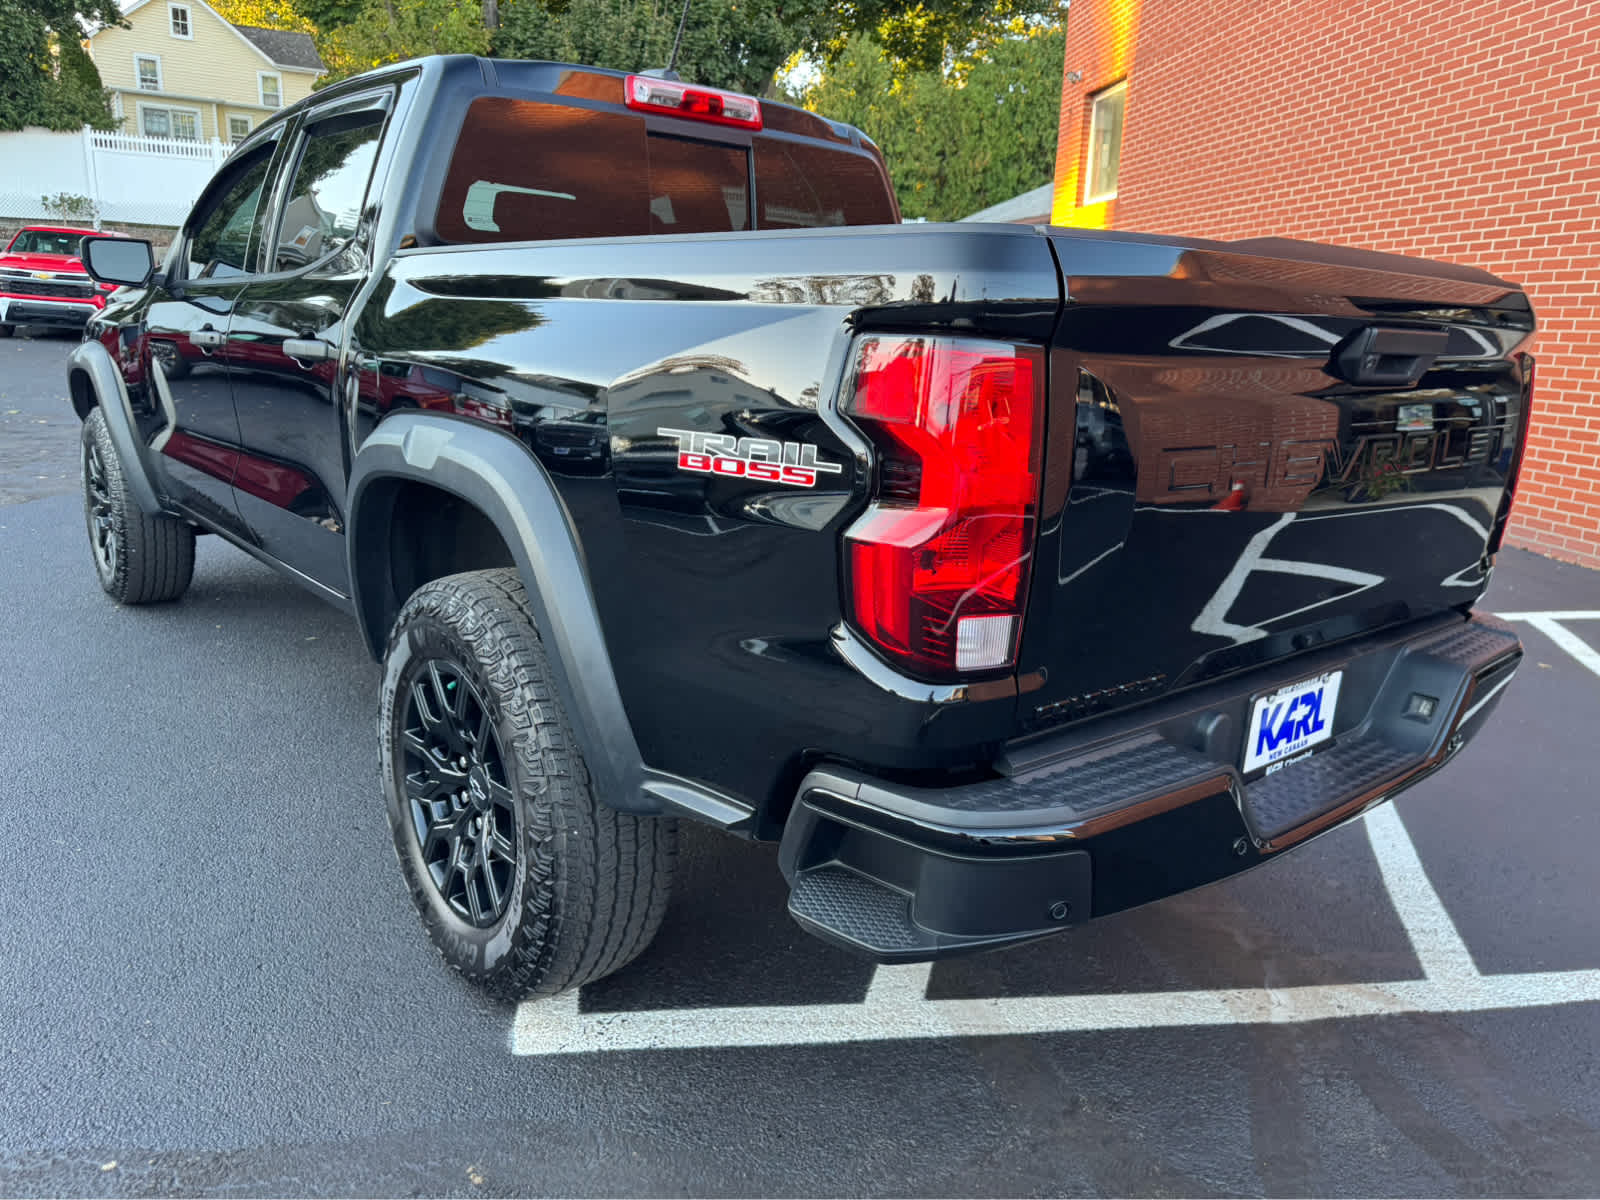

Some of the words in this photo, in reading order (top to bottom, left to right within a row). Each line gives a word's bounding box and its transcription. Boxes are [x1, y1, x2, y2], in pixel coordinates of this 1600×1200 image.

[657, 427, 842, 473] TRAIL
[677, 452, 816, 487] BOSS
[1256, 688, 1325, 757] KARL
